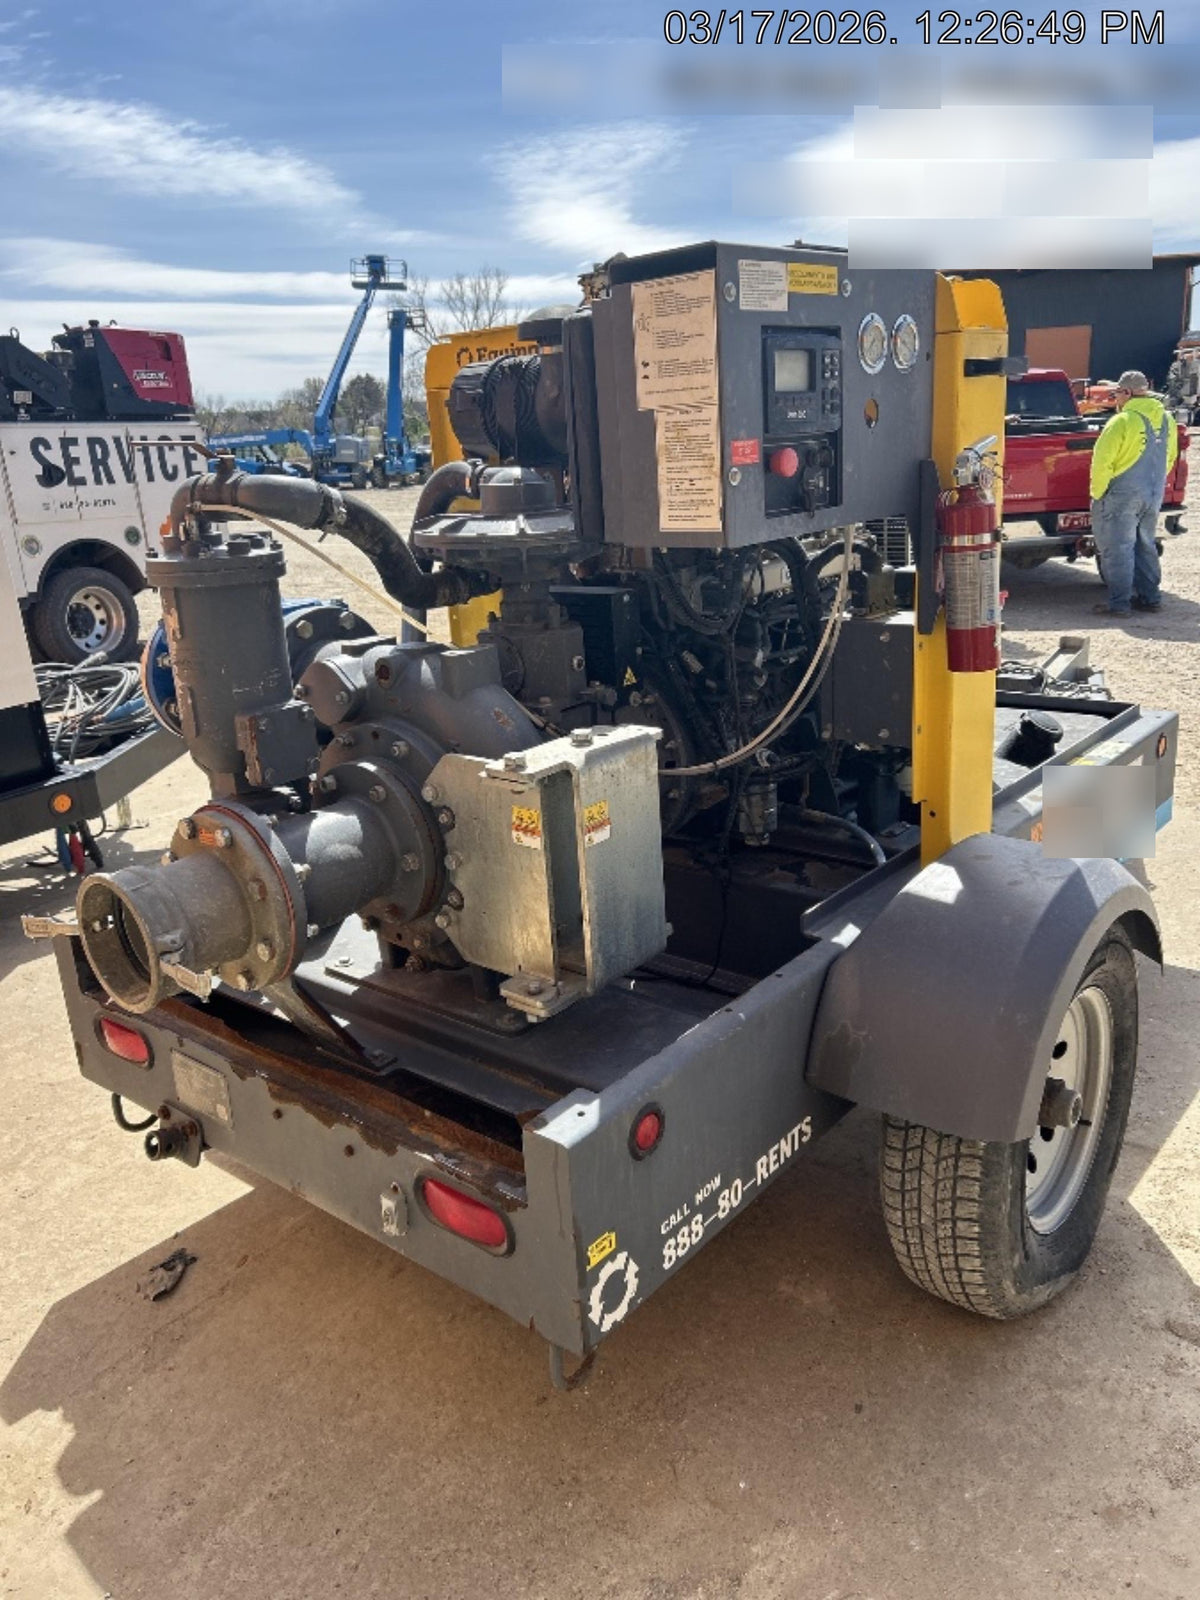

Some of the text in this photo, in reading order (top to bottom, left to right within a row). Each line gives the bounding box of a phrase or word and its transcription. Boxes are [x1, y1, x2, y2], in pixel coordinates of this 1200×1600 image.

[30, 435, 202, 488] SERVICE
[661, 1173, 722, 1234] CALL NOW
[662, 1116, 812, 1271] 888-80-RENTS
